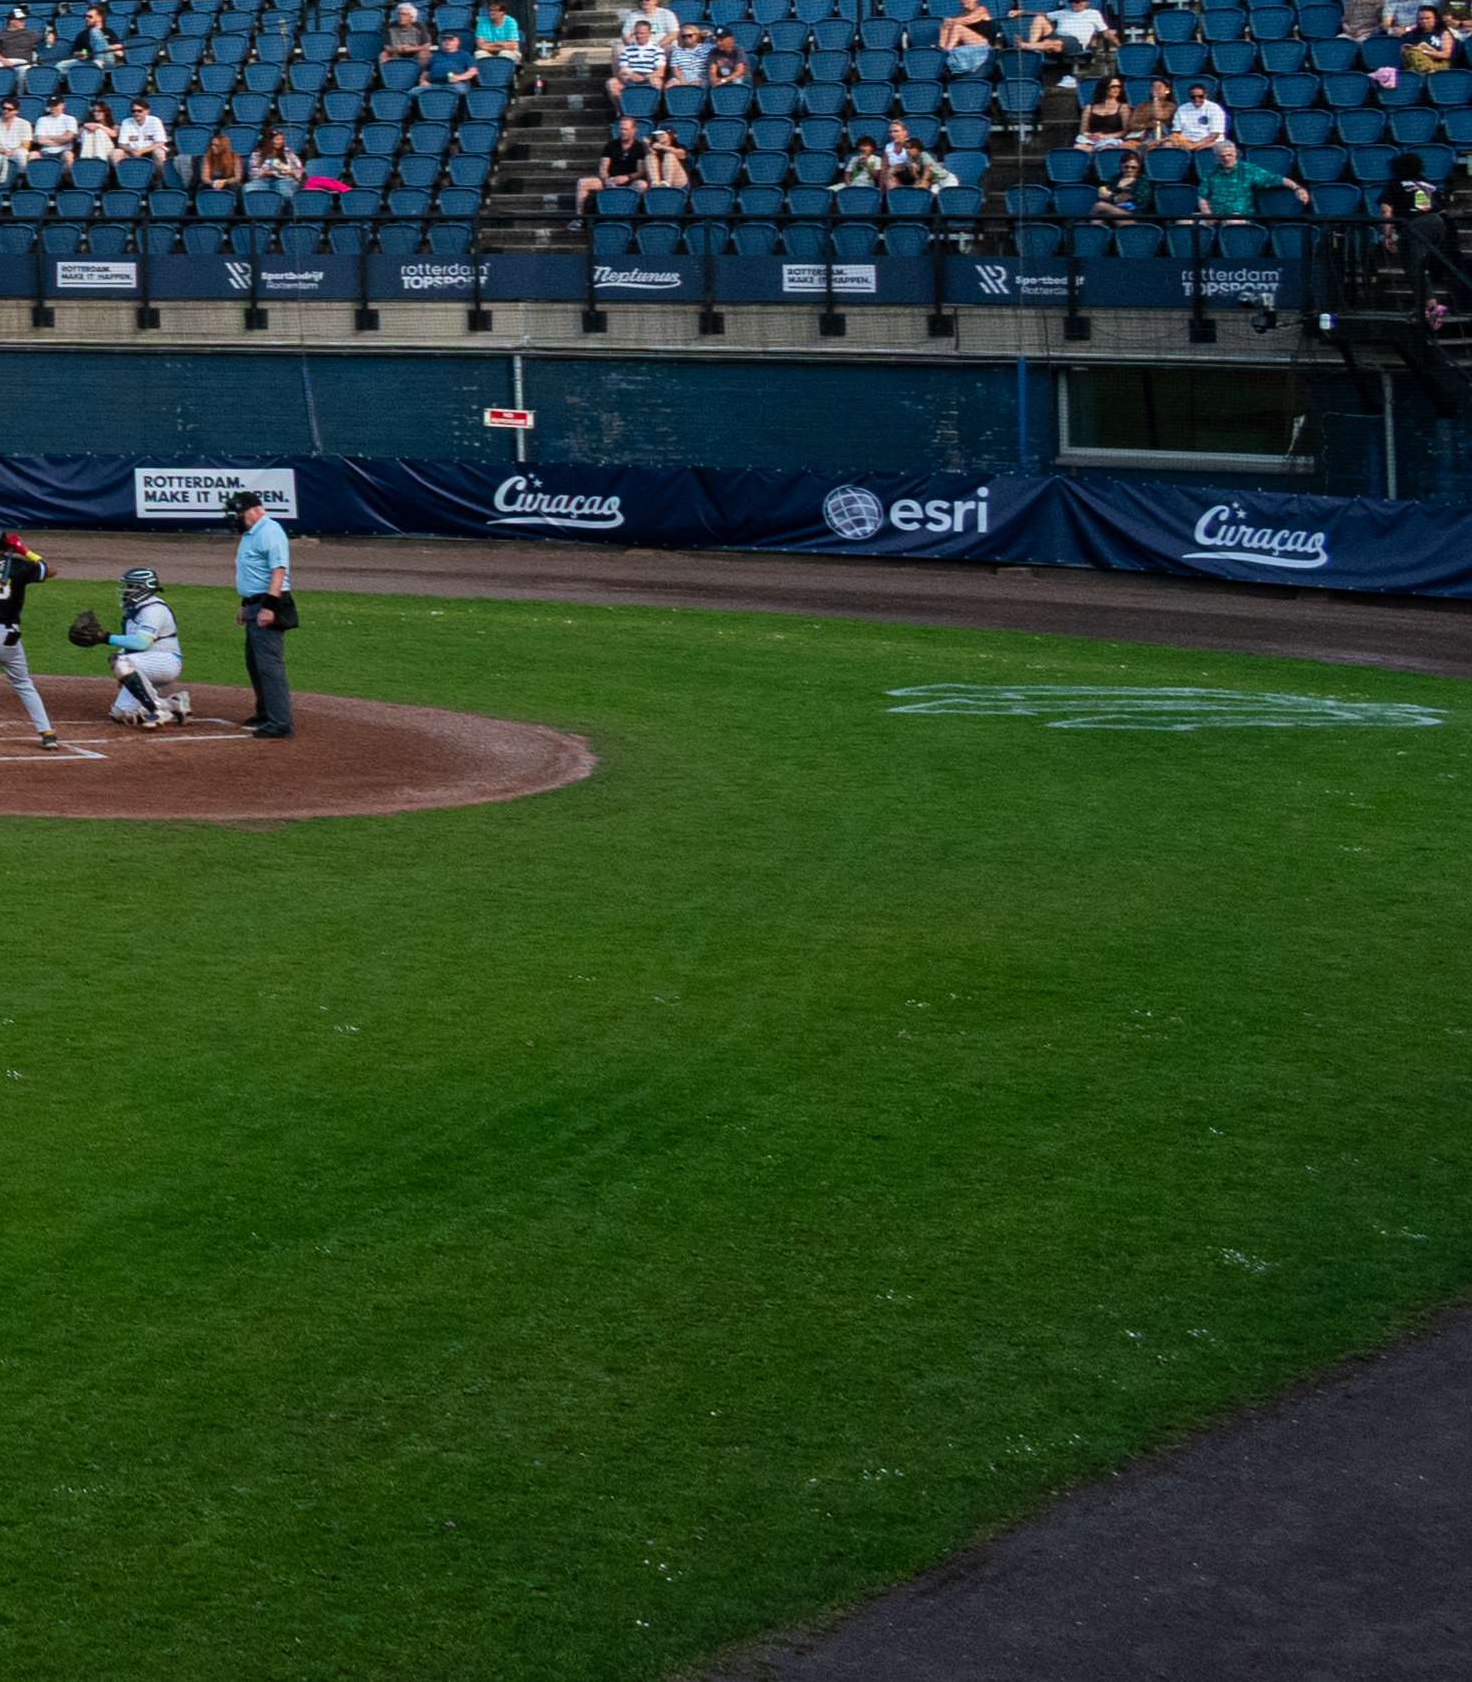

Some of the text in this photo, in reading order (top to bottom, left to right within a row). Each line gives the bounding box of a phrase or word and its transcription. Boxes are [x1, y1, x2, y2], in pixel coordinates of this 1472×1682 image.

[592, 265, 682, 289] Neptunus
[144, 475, 246, 489] ROTTERDAM.
[145, 490, 189, 503] MAKE
[197, 491, 210, 503] IT
[487, 475, 624, 529] Curaçao
[890, 486, 989, 533] esri
[1183, 505, 1328, 568] Curaçao
